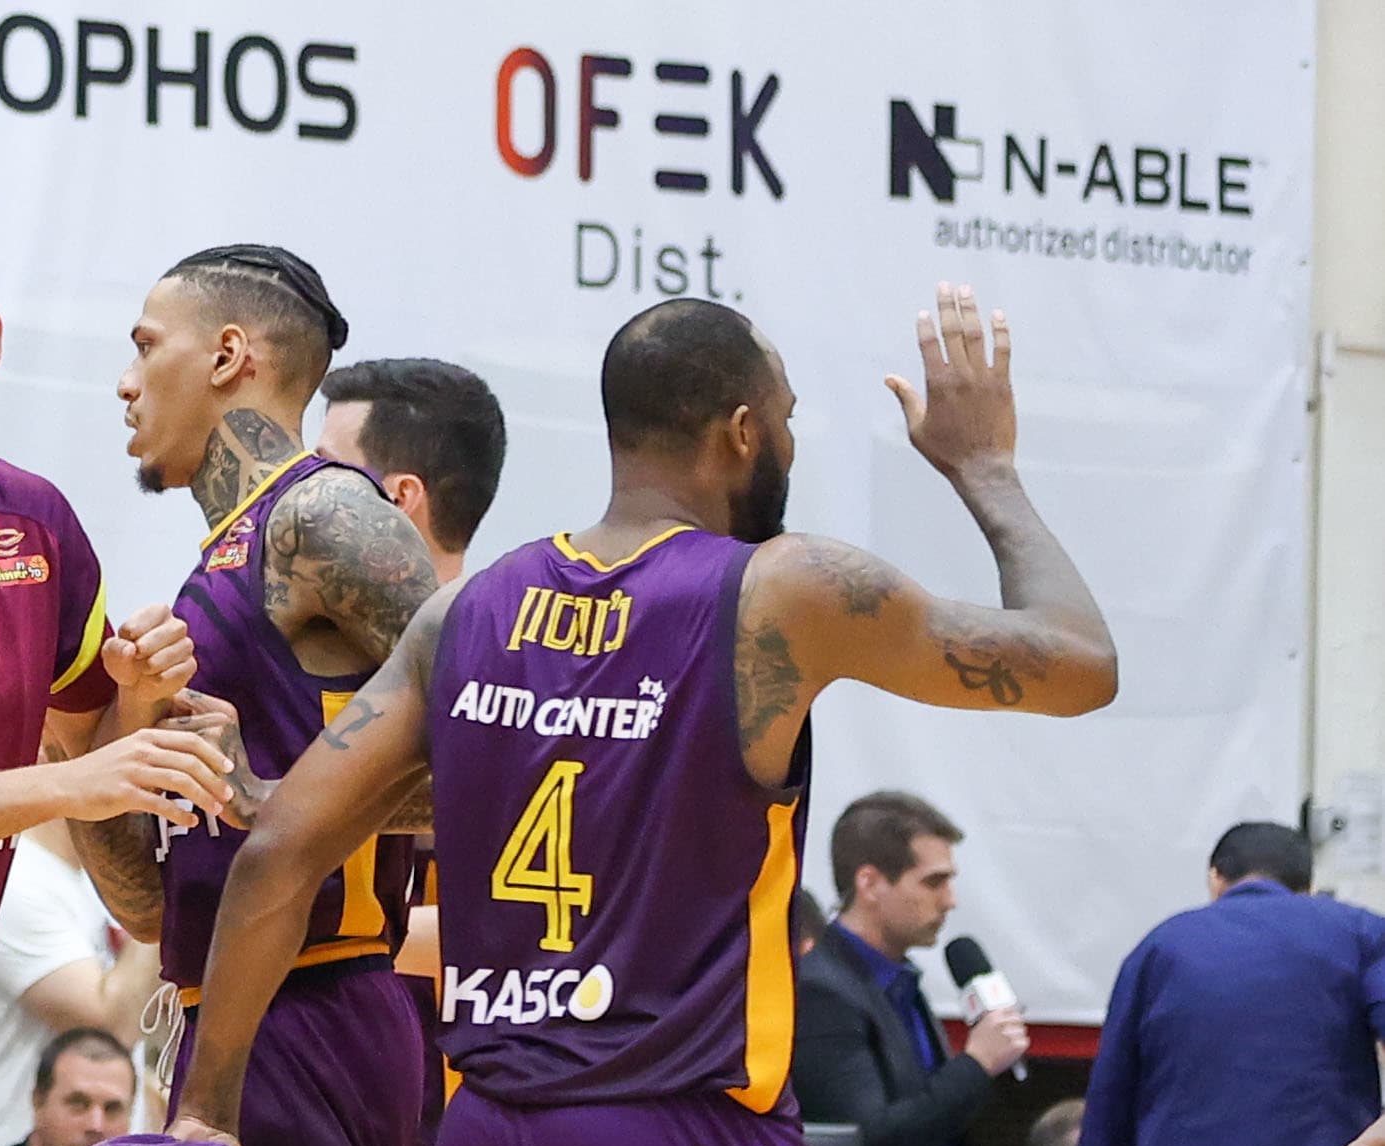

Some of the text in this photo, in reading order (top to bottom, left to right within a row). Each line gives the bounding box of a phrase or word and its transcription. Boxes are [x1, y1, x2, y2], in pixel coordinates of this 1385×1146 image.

[496, 46, 785, 200] OFEK
[1003, 133, 1254, 216] N-ABLE
[575, 220, 742, 301] Dist.
[934, 216, 1252, 273] authorized distributor
[450, 681, 656, 739] AUTO CENTER
[491, 760, 593, 953] 4
